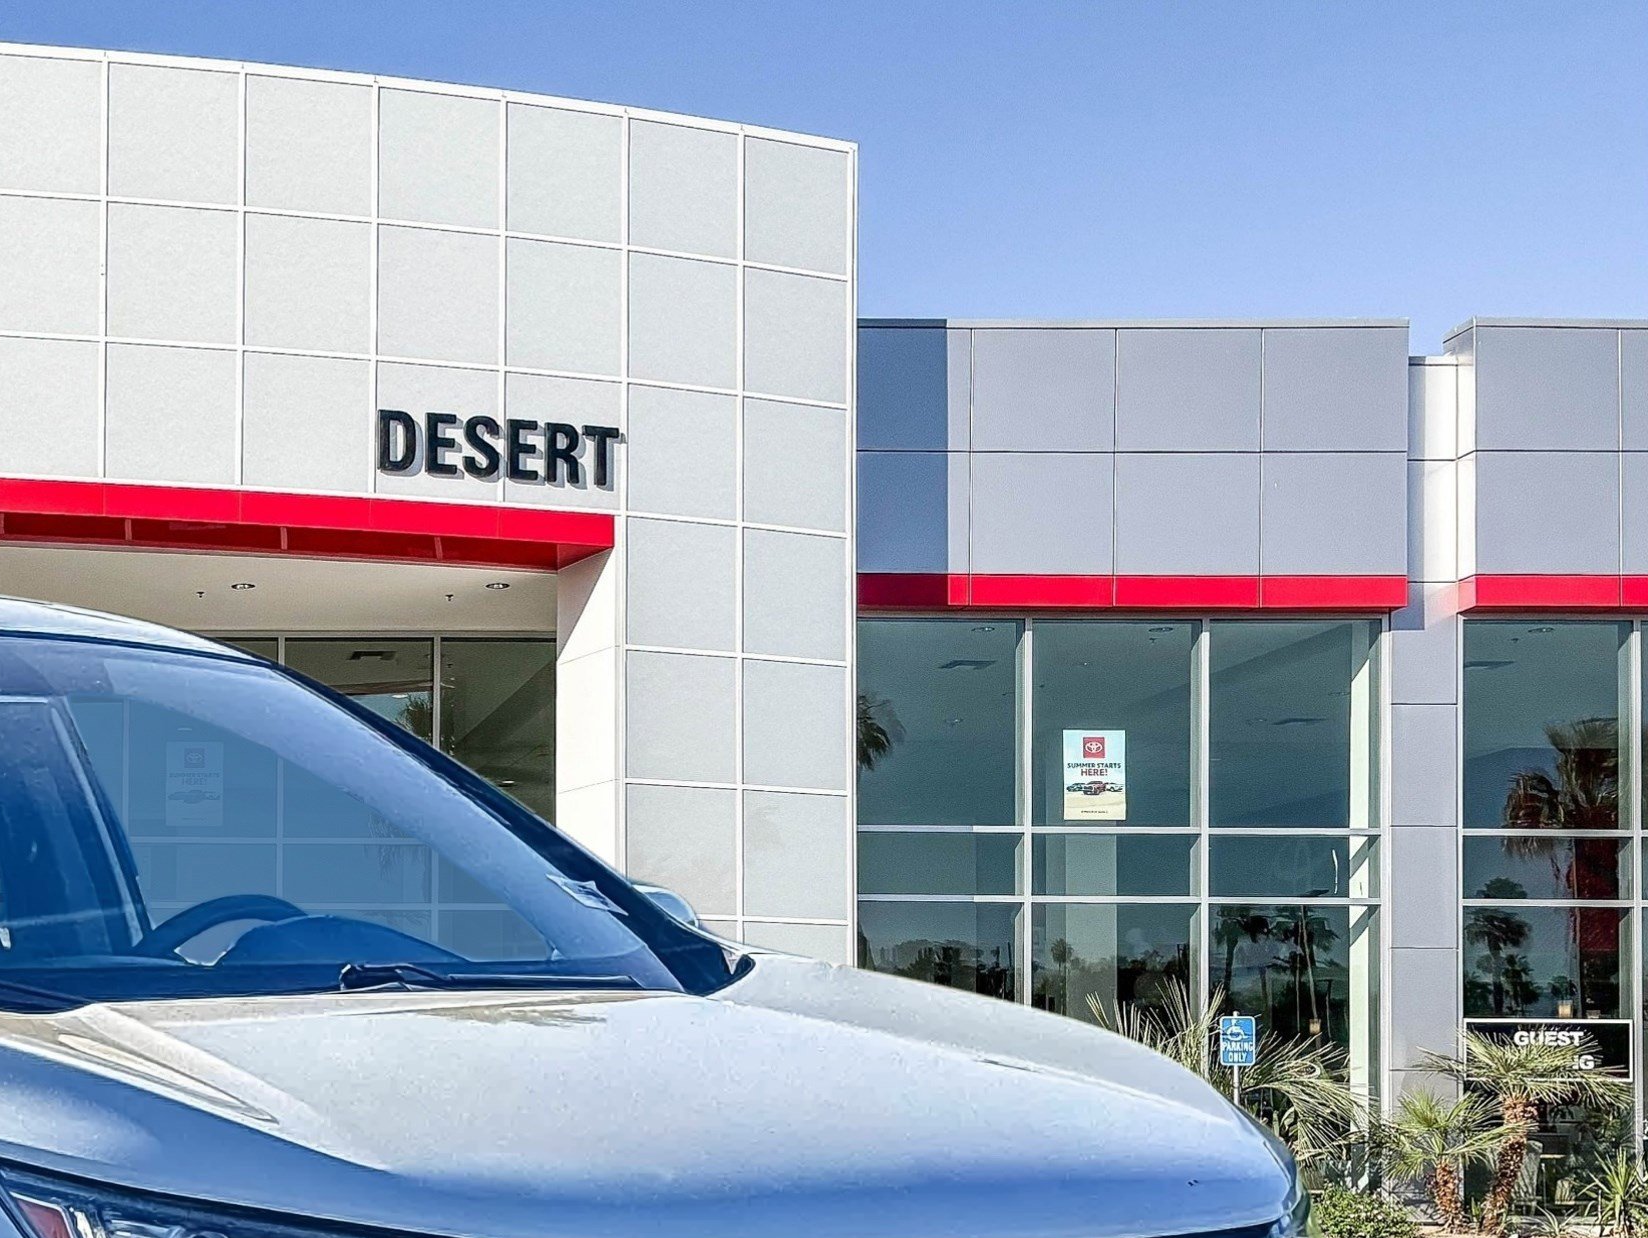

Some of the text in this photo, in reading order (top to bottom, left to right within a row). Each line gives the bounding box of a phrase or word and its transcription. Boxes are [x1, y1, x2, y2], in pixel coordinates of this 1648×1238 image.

[377, 409, 620, 486] DESERT
[1080, 768, 1108, 776] HERE!
[1513, 1030, 1584, 1047] GUEST
[1222, 1041, 1253, 1051] PARKING
[1229, 1052, 1248, 1062] ONLY
